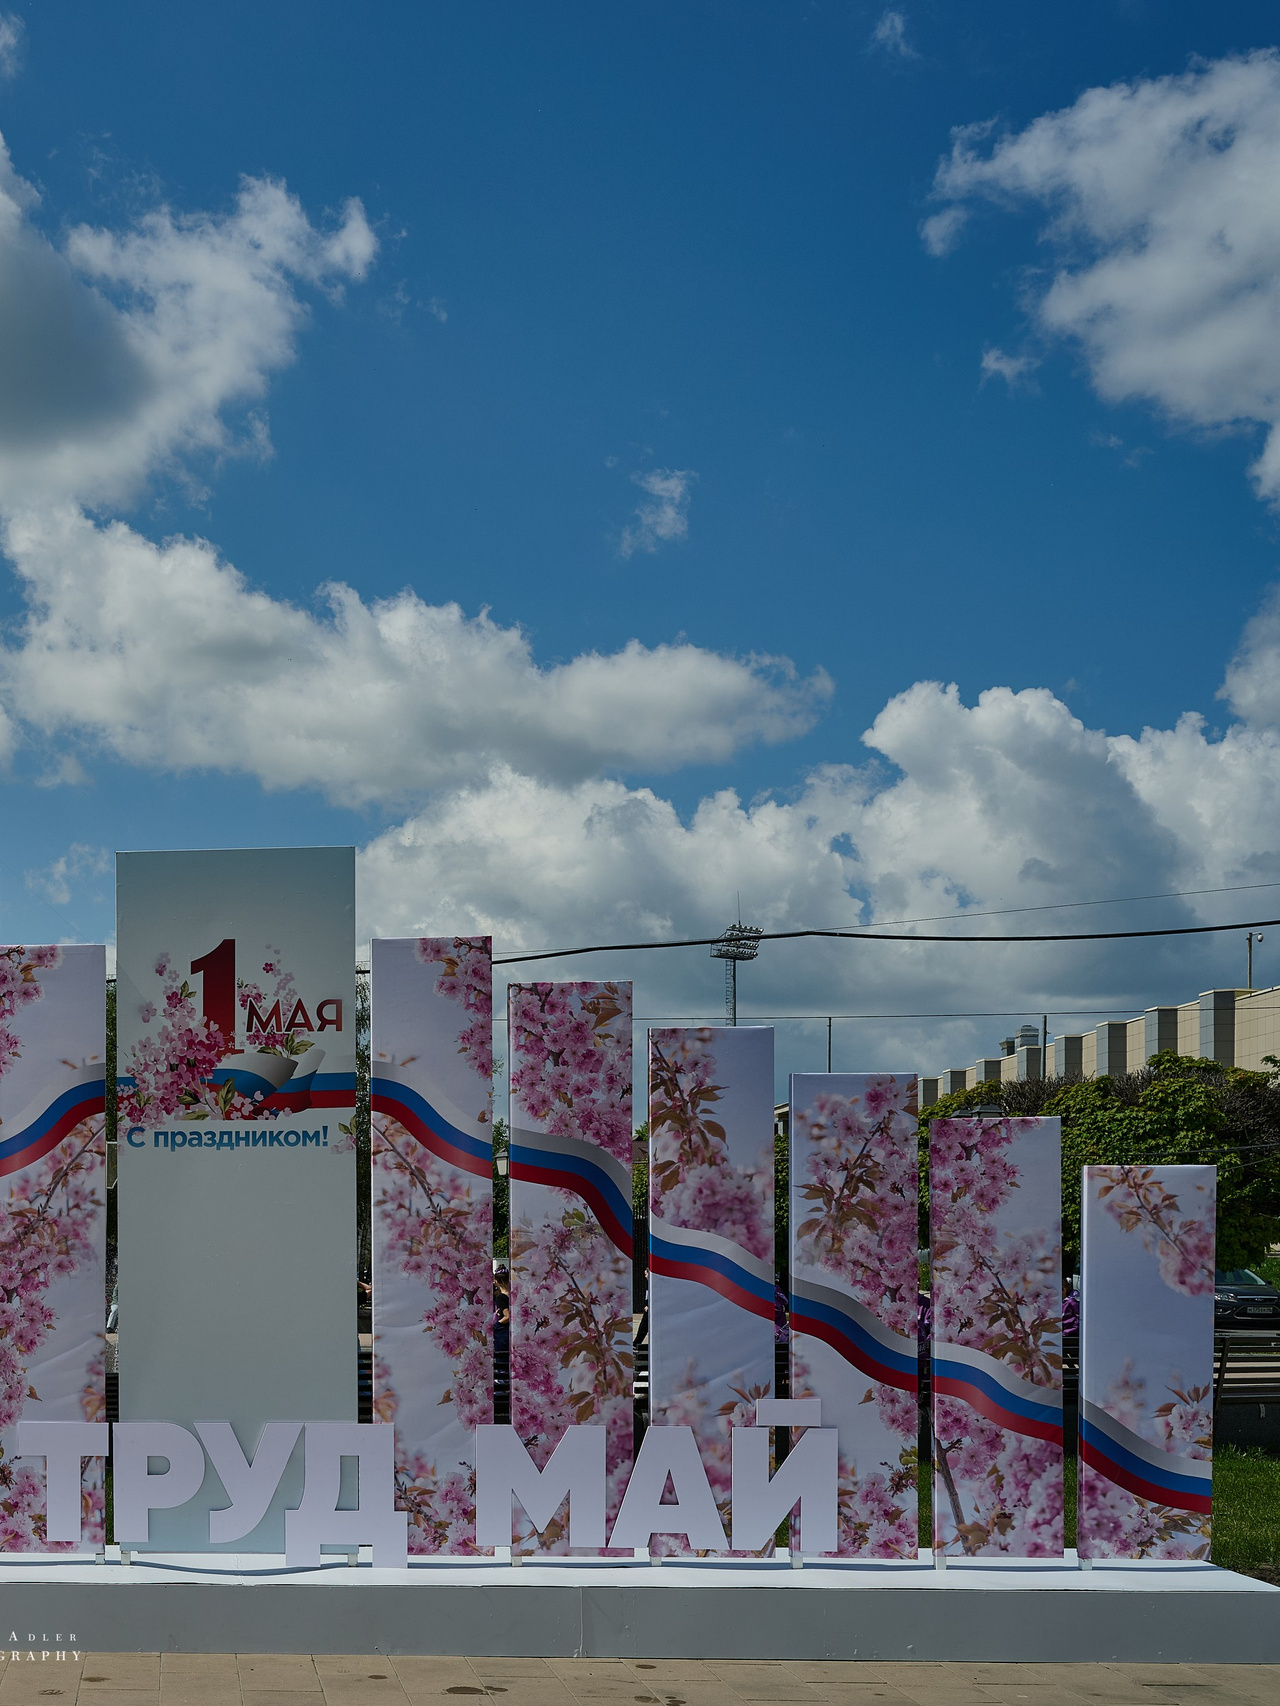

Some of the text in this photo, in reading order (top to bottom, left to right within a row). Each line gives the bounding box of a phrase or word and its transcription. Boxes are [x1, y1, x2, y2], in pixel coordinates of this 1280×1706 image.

[190, 938, 343, 1054] 1 МАЯ
[126, 1125, 329, 1152] С праздником!
[19, 1421, 408, 1568] ТРУД
[475, 1398, 839, 1552] МАЙ
